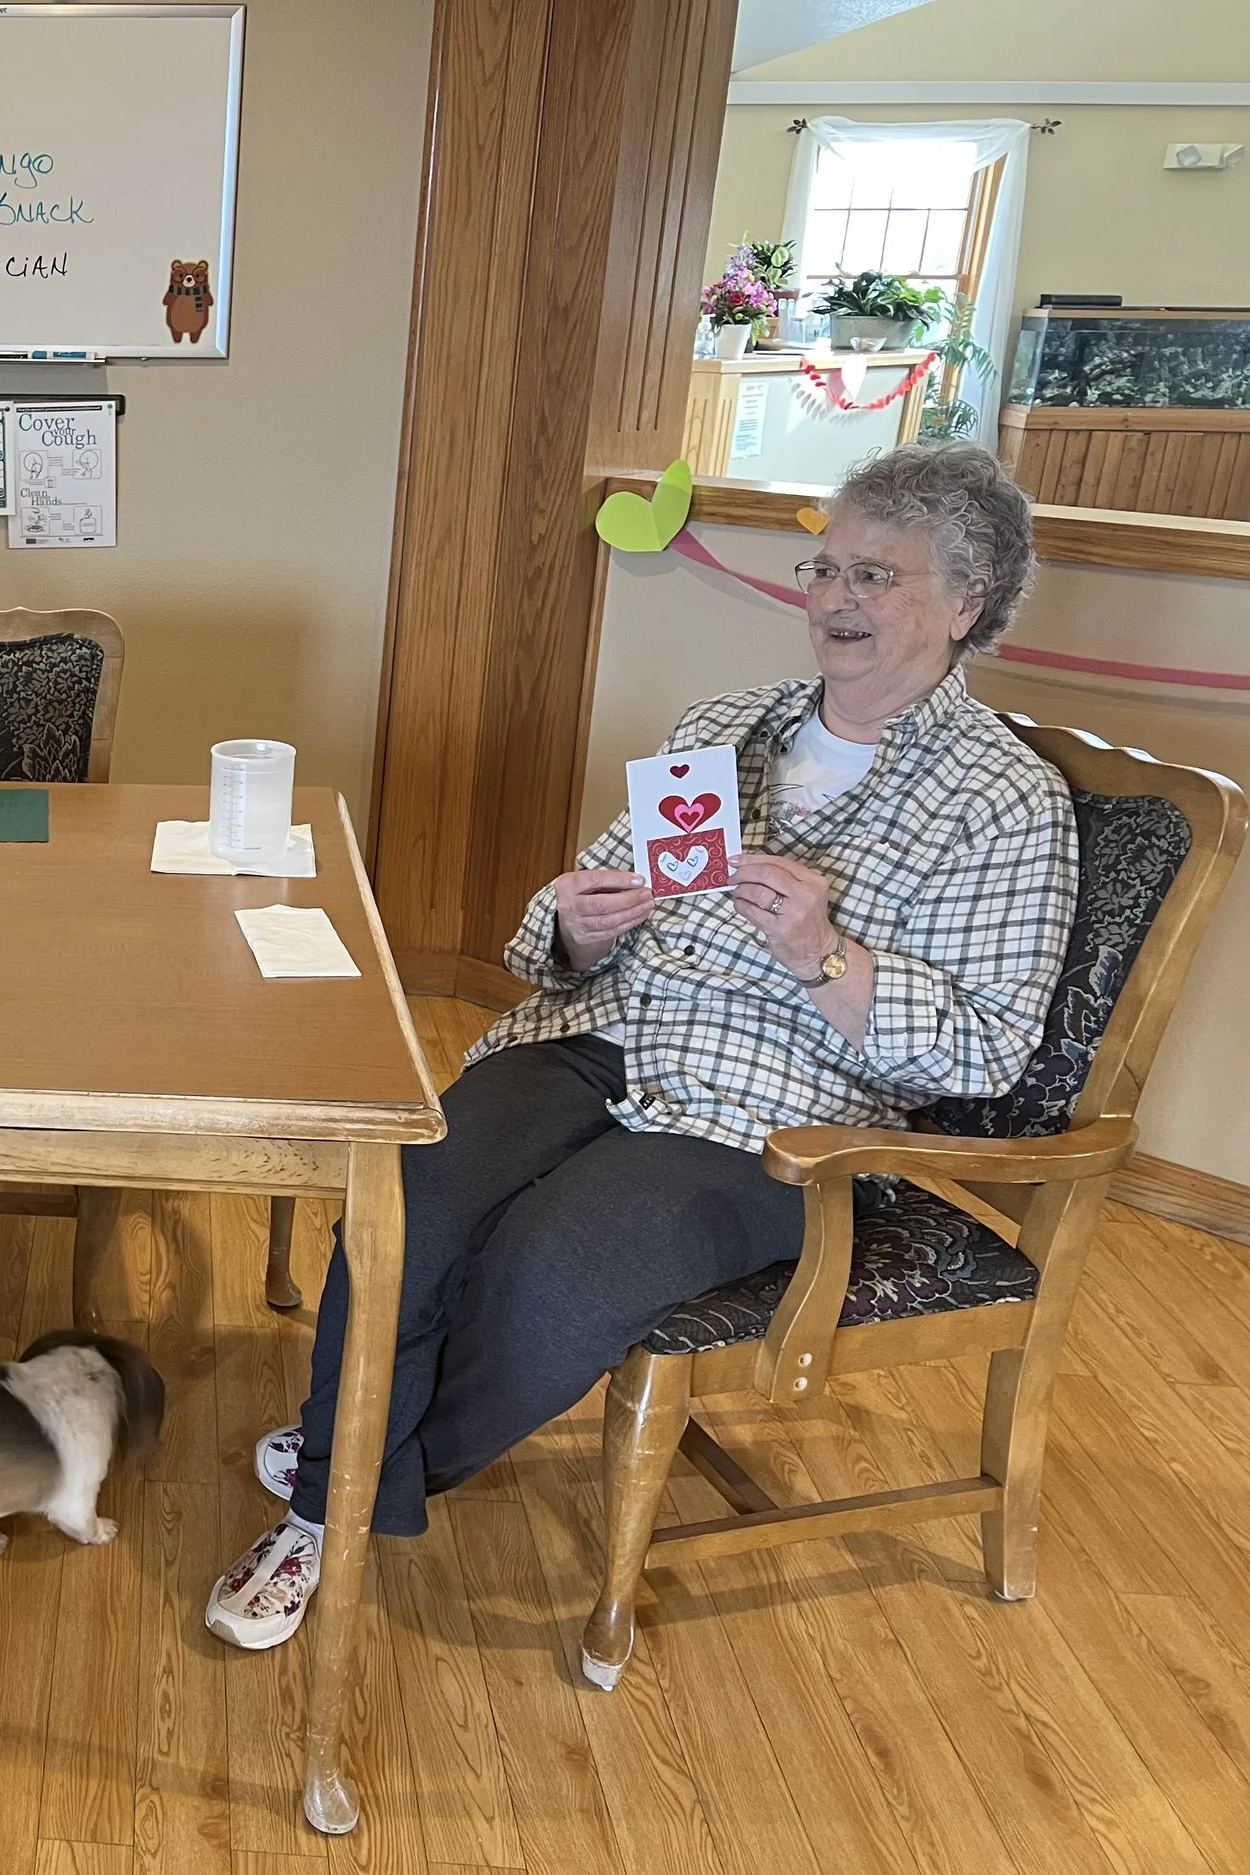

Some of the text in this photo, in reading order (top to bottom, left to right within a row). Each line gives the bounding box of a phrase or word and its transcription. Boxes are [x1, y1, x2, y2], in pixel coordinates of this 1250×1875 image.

[18, 414, 75, 431] Cover
[54, 428, 76, 436] your
[42, 429, 97, 449] Cough
[21, 488, 48, 498] Clean
[32, 497, 62, 506] Hands
